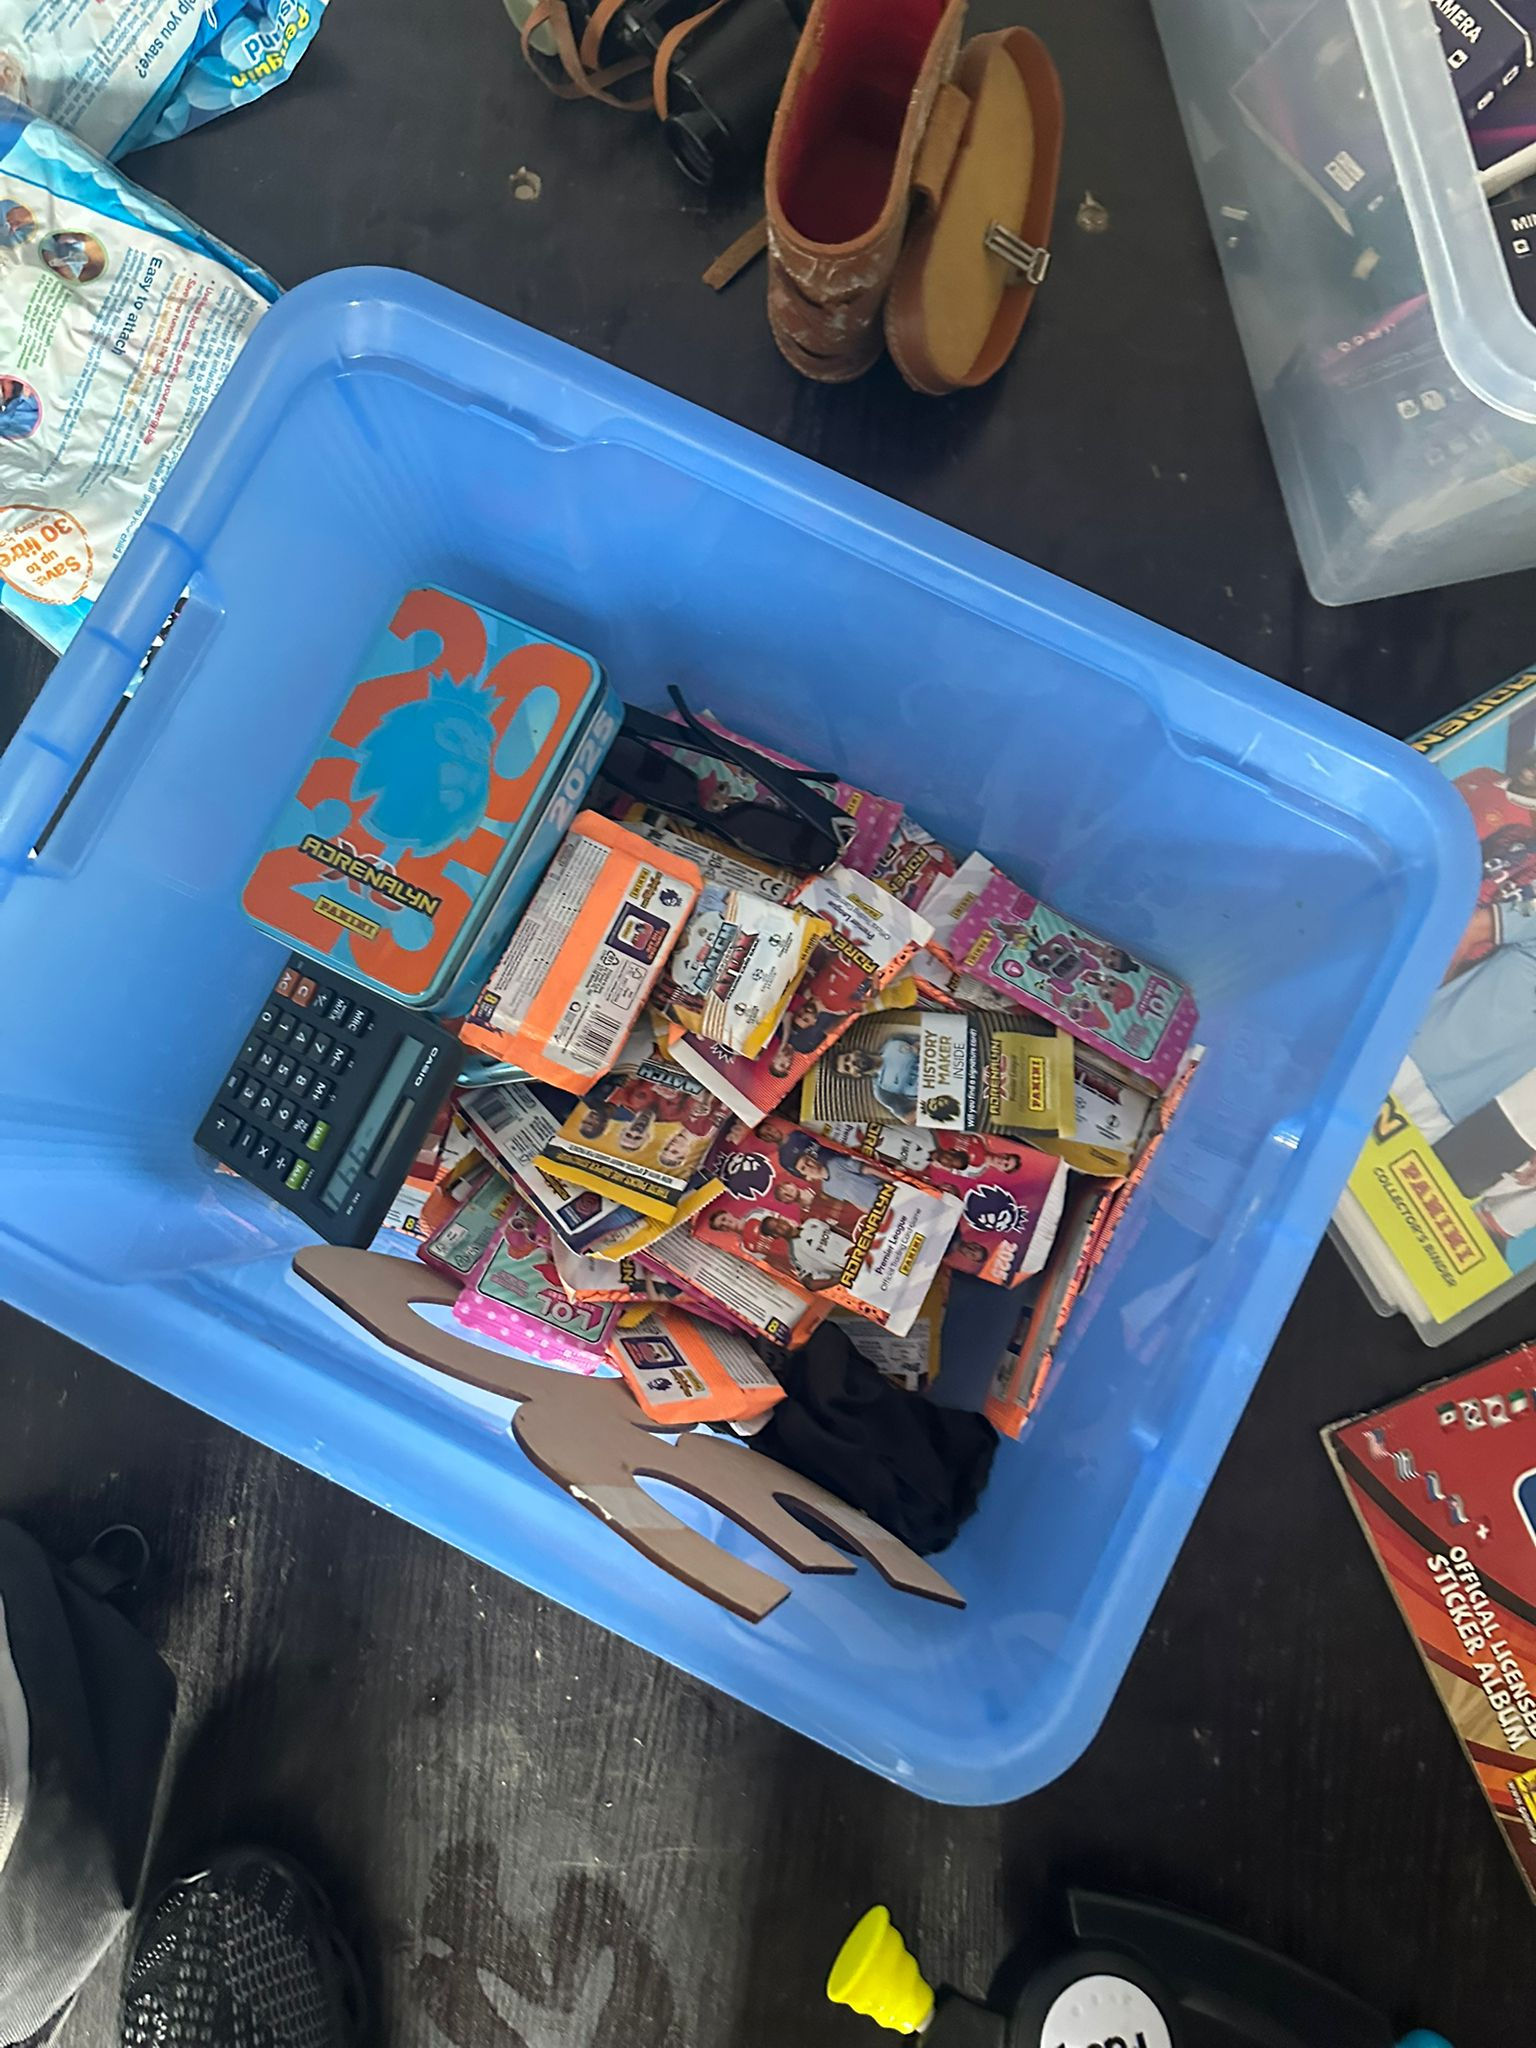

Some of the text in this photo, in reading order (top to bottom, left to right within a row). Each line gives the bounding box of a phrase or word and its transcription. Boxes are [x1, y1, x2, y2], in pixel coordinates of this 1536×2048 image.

[155, 10, 184, 40] you
[130, 36, 169, 79] save?
[231, 5, 310, 89] Penguin
[137, 255, 163, 293] Easy
[132, 294, 147, 311] to
[110, 310, 141, 358] attach
[38, 515, 73, 544] 30
[0, 533, 42, 570] litre
[24, 547, 59, 576] up to
[543, 708, 621, 833] 2025
[297, 831, 442, 919] ADRENALYN
[691, 918, 738, 993] MATCH
[709, 926, 758, 1002] ATTAX
[277, 971, 293, 990] AC
[296, 984, 309, 997] C
[260, 1010, 272, 1022] 0
[278, 1021, 289, 1031] 1
[346, 1008, 364, 1032] MRC
[294, 1030, 307, 1043] 4
[312, 1041, 325, 1054] 7
[259, 1053, 272, 1065] 2
[276, 1063, 289, 1076] 5
[412, 1045, 439, 1088] CASIO
[921, 1029, 938, 1088] HISTORY
[937, 1035, 953, 1085] MAKER
[951, 1042, 966, 1079] INSIDE
[969, 1048, 977, 1078] signature
[989, 1039, 1001, 1114] ADRENALYN
[242, 1086, 254, 1098] 3
[294, 1073, 307, 1087] 8
[635, 1061, 704, 1095] MATCH
[967, 1085, 975, 1098] find
[258, 1095, 272, 1109] 6
[276, 1107, 290, 1120] 9
[967, 1113, 975, 1126] Will
[968, 1100, 977, 1112] you
[1371, 1164, 1429, 1245] COLLECTOR'S
[1422, 1242, 1458, 1289] BINDER
[1399, 1159, 1476, 1265] PANINI
[840, 1181, 896, 1288] ADRENALYN
[874, 1213, 908, 1274] Premier League
[878, 1266, 894, 1291] Official
[888, 1242, 906, 1267] Trading
[900, 1235, 923, 1272] PANINI
[530, 1292, 593, 1330] LOL
[1445, 1542, 1501, 1639] OFFICIAL
[1424, 1550, 1485, 1657] STICKER
[1472, 1655, 1530, 1753] ALBUM
